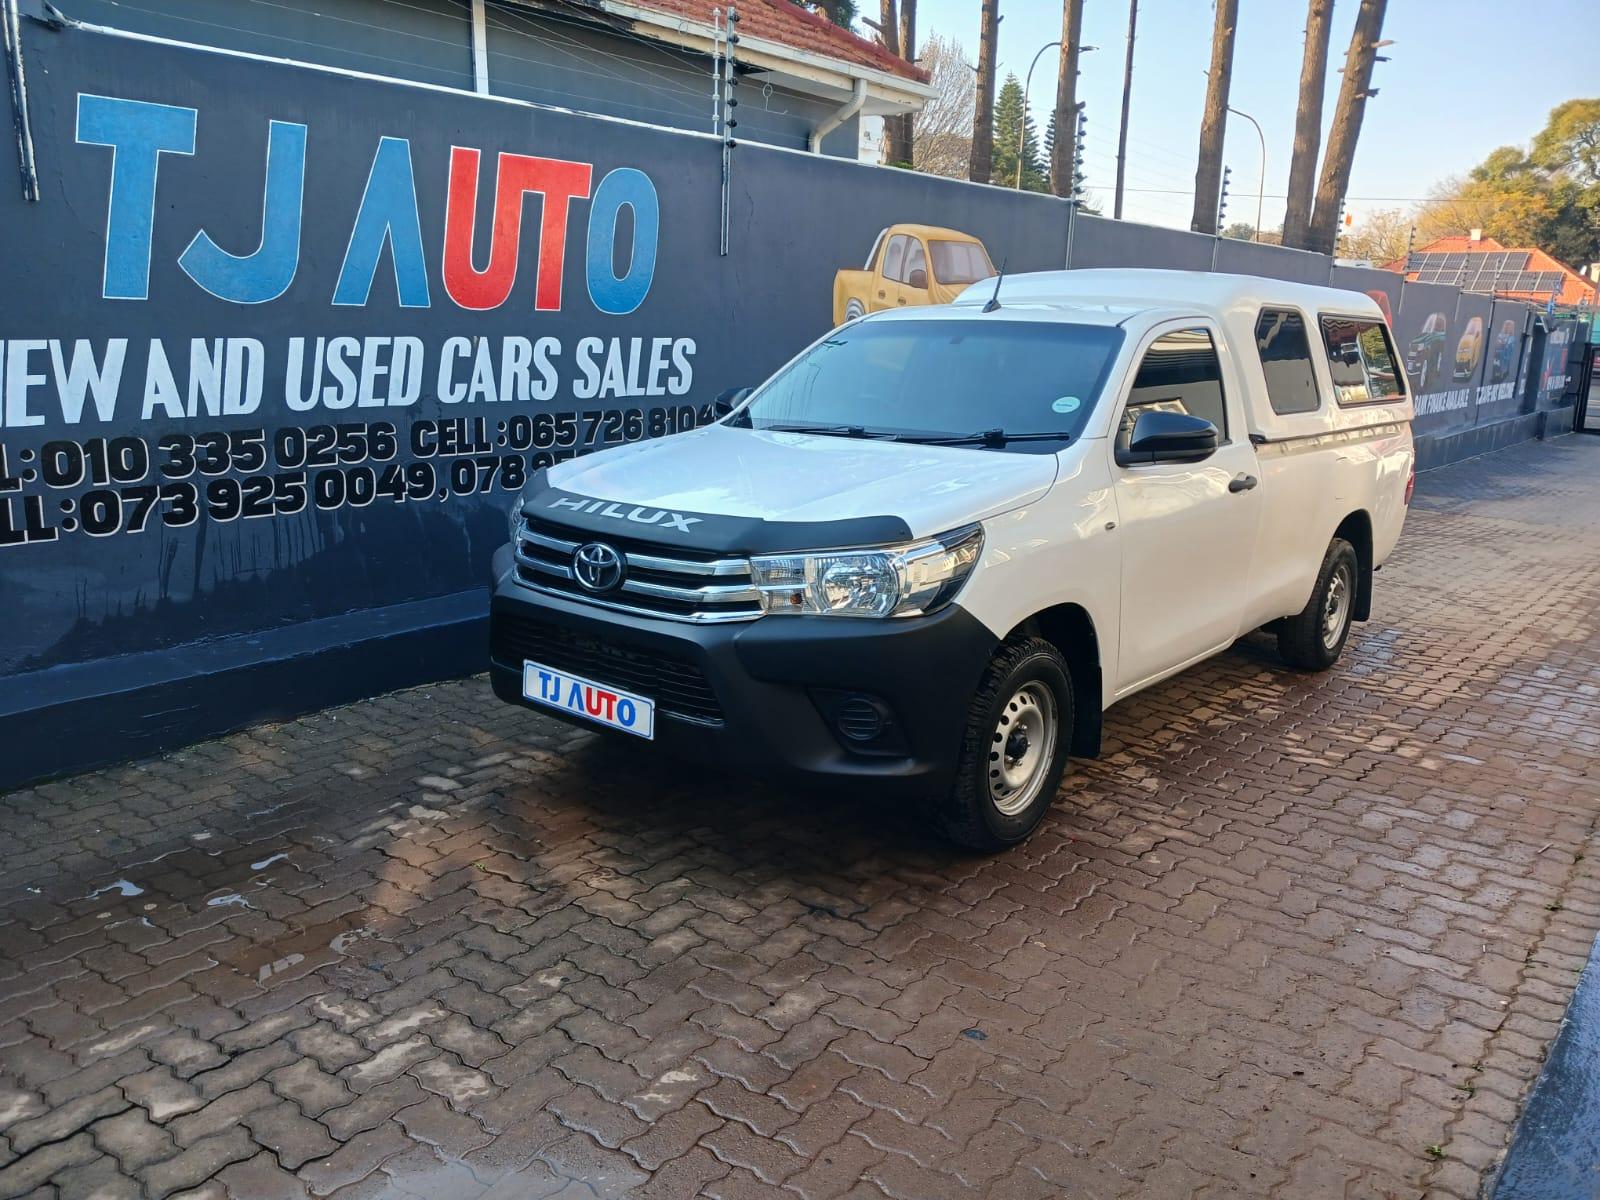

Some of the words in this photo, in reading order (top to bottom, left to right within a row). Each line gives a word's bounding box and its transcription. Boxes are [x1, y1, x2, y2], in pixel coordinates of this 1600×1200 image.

[75, 92, 308, 305] TJ
[331, 135, 660, 315] AUTO
[0, 338, 129, 427] EW
[141, 337, 265, 420] AND
[285, 336, 424, 411] USED
[437, 336, 562, 404] CARS
[573, 337, 697, 399] SALES
[158, 429, 266, 479] 335
[275, 421, 397, 469] 0256
[583, 408, 643, 446] 726
[207, 472, 307, 522] 925
[547, 497, 705, 534] HILUX
[538, 671, 561, 703] TJ
[567, 682, 636, 727] AUTO
